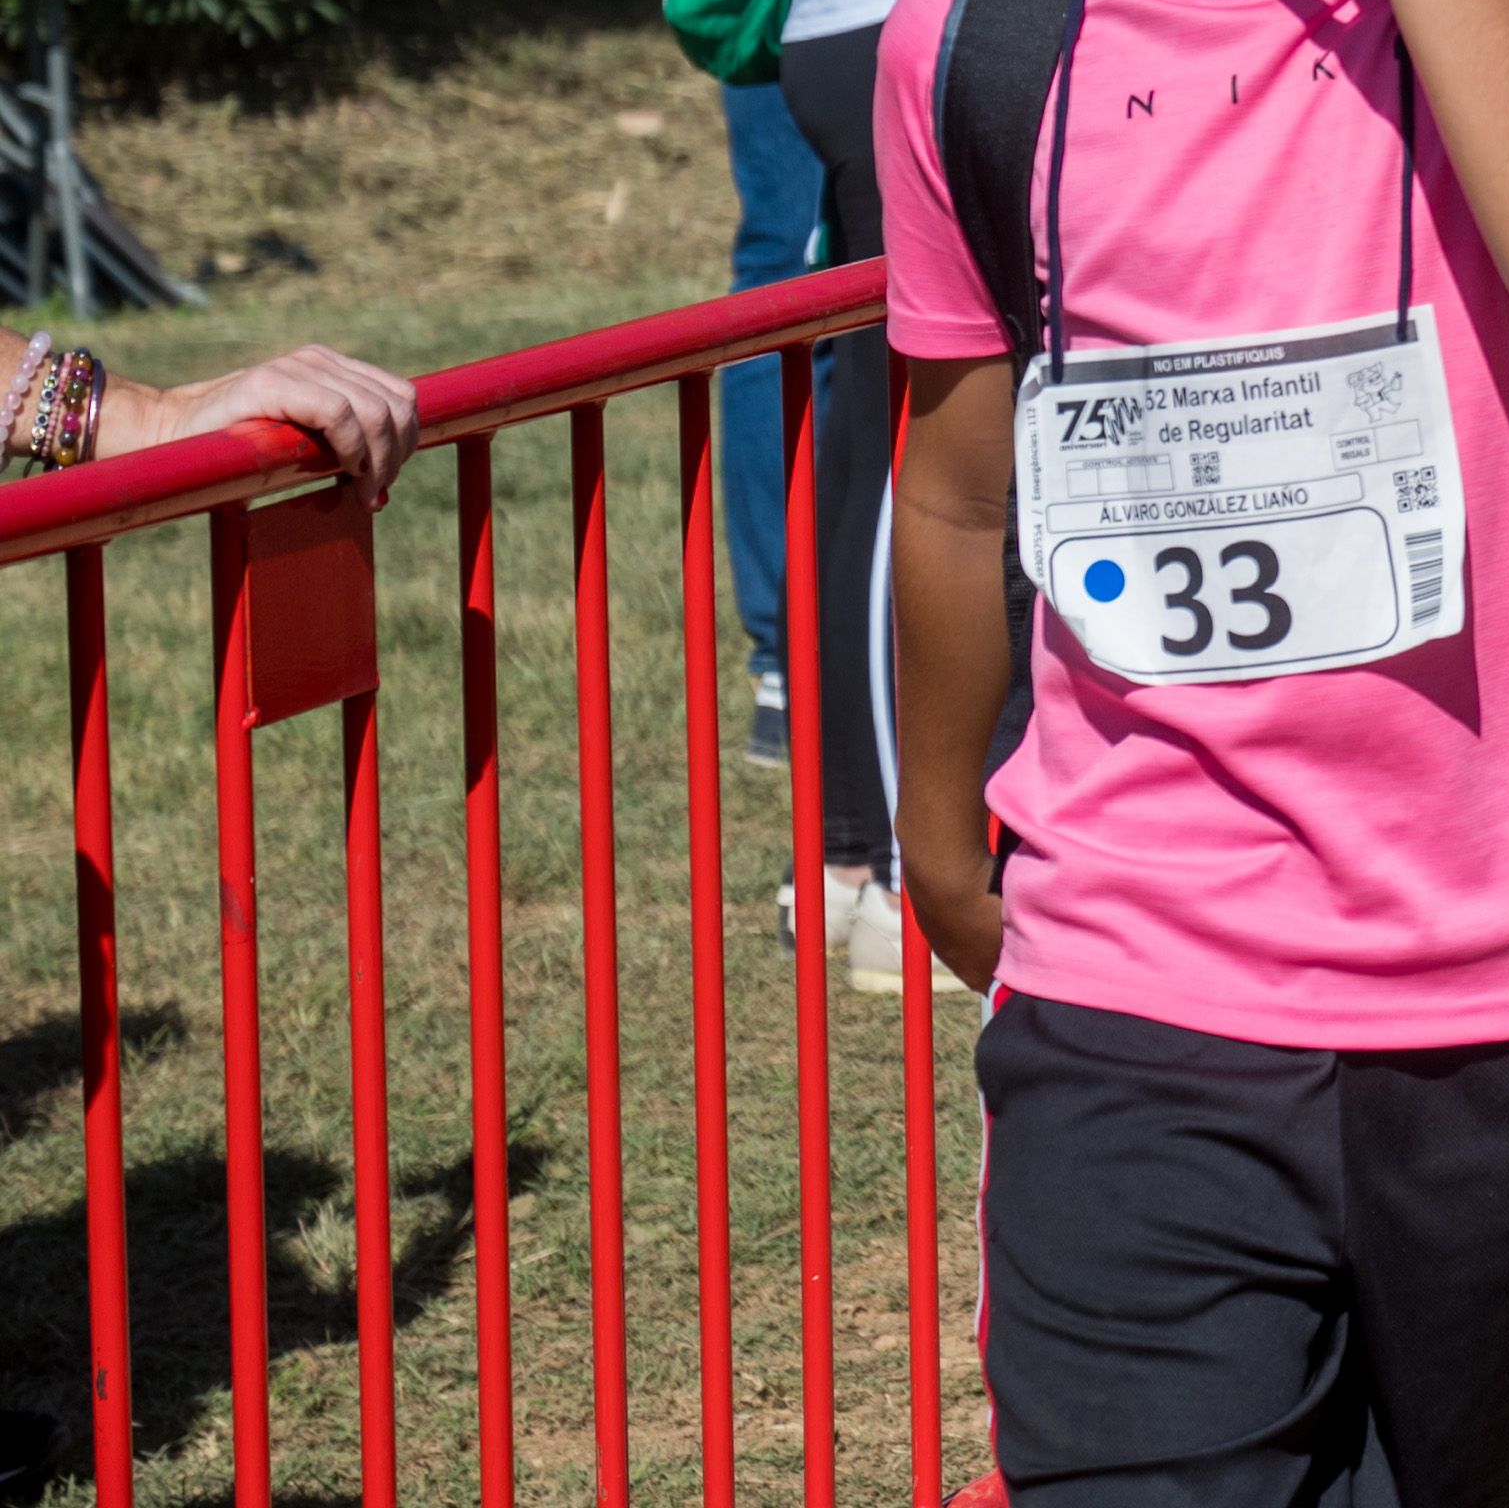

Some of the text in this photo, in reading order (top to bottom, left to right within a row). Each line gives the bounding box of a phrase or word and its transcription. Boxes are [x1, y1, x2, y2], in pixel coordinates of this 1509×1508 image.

[1126, 51, 1336, 120] NIK
[1153, 346, 1286, 373] NO EM PLASTIFIQUIS
[1145, 371, 1322, 412] 52 Marxa Infantil
[1026, 407, 1037, 426] 112
[1158, 421, 1183, 444] de
[1187, 407, 1314, 444] Regularitat
[1163, 492, 1248, 520] GONZÁLEZ
[1252, 485, 1309, 511] LIAÑO
[1154, 539, 1293, 657] 33
